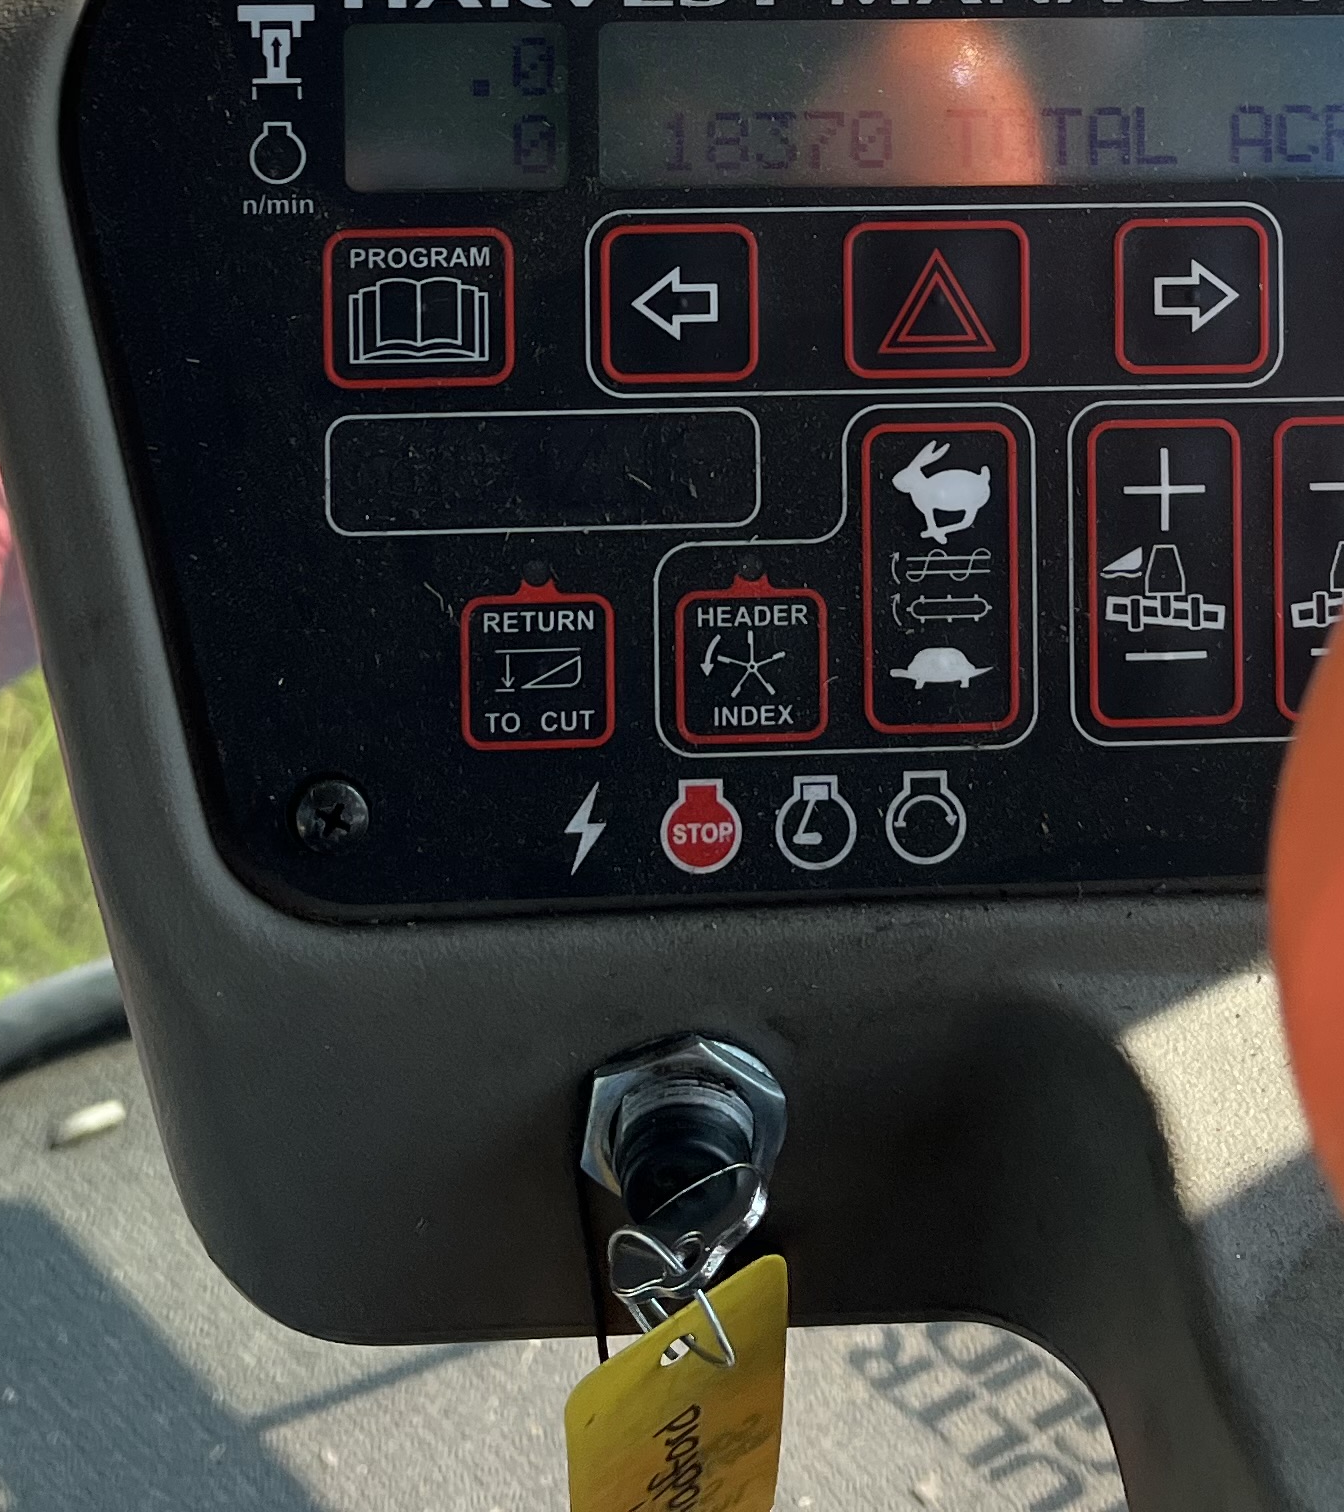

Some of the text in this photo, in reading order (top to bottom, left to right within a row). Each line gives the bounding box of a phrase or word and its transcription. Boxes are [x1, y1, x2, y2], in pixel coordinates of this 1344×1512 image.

[513, 114, 556, 174] 0
[664, 110, 893, 171] 18370
[947, 106, 1178, 167] TOTAL
[242, 193, 315, 216] n/min
[349, 246, 491, 270] PROGRAM
[482, 609, 595, 634] RETURN
[696, 604, 809, 628] HEADER
[484, 709, 595, 734] TO CUT
[713, 704, 794, 728] INDEX
[671, 822, 734, 847] STOP
